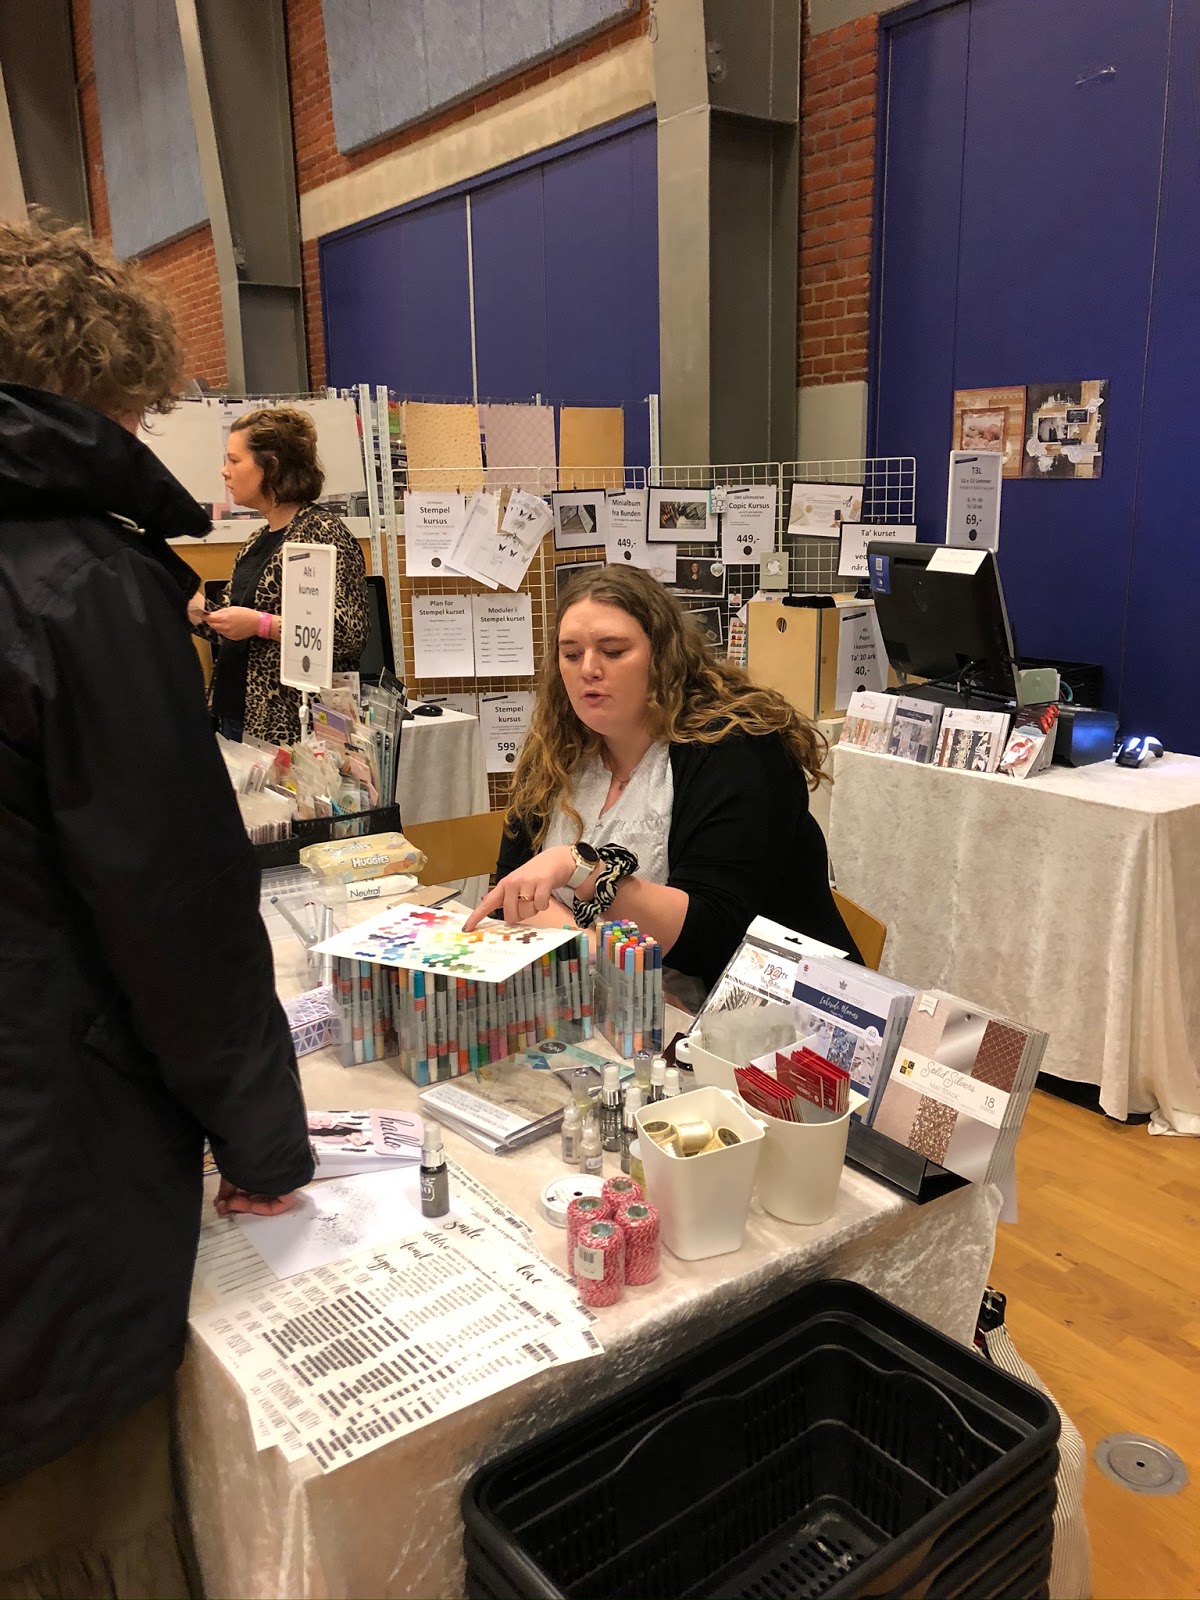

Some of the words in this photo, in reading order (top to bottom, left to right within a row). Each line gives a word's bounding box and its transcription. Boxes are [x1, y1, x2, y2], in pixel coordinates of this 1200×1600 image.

[966, 514, 982, 526] 69,-
[617, 538, 636, 548] 449,-
[736, 534, 760, 544] 449,-
[303, 566, 312, 578] Alt
[313, 568, 316, 578] i
[298, 584, 319, 596] kurven
[294, 624, 322, 651] 50%
[855, 666, 870, 676] 40,-
[350, 886, 381, 898] Neutral
[920, 1061, 950, 1079] Solid
[943, 1072, 975, 1092] Silvers
[985, 1096, 995, 1108] 18
[442, 1220, 486, 1239] smile
[516, 1264, 542, 1284] love
